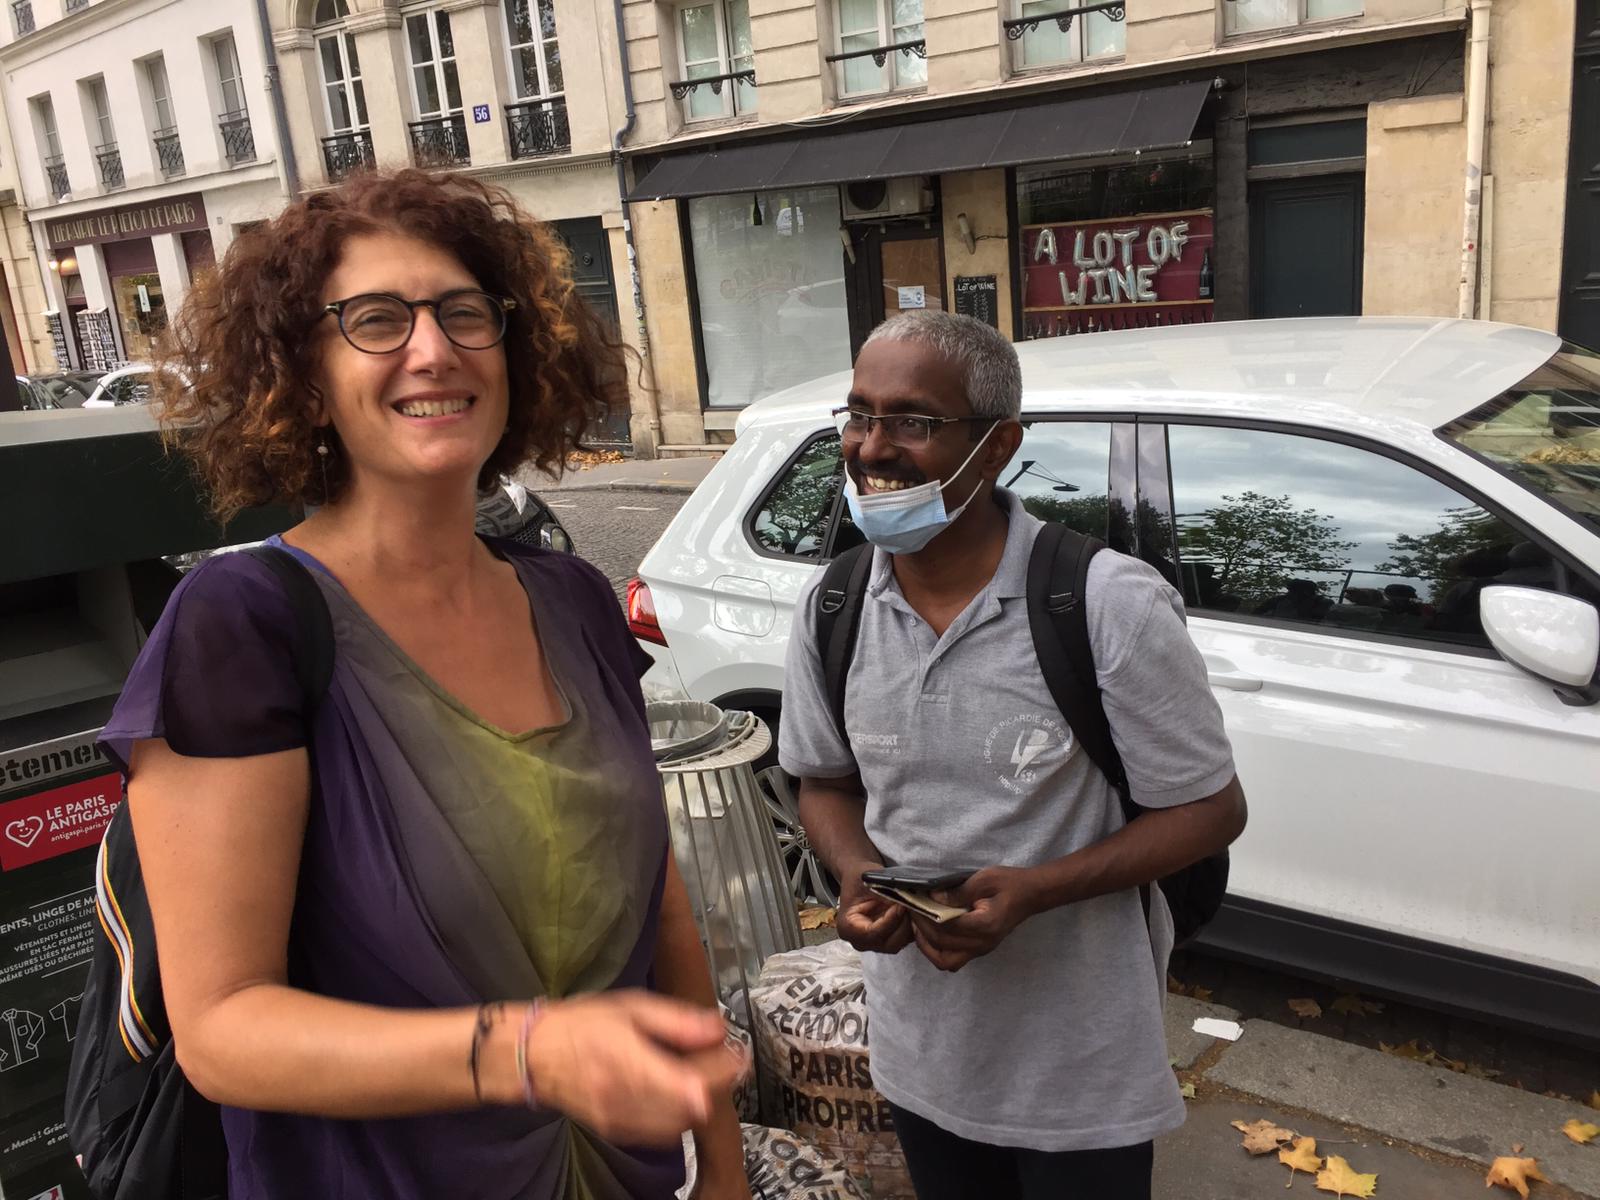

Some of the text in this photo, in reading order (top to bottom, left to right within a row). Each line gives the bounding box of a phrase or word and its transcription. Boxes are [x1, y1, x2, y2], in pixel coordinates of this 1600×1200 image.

[475, 107, 488, 120] 56
[53, 218, 96, 242] LIBRAIRIE
[97, 215, 110, 236] LE
[149, 206, 165, 228] DE
[163, 202, 195, 226] PARIS
[1034, 221, 1190, 268] A LOT OF
[957, 282, 970, 291] LOT
[977, 281, 996, 290] WINE
[1059, 264, 1158, 305] WINE
[983, 738, 993, 764] LIGUE
[999, 714, 1041, 728] PICARDIE
[1042, 718, 1056, 729] DE
[46, 794, 106, 820] LE PARIS
[32, 905, 66, 923] LINGE
[67, 899, 82, 911] DE
[14, 921, 92, 952] VÊTEMENTS ET LINGE
[30, 947, 41, 956] EN
[42, 942, 58, 952] SAC
[58, 931, 83, 946] FERMÉ
[39, 949, 60, 961] LIÉES
[61, 943, 76, 954] PAR
[24, 963, 44, 975] USÉS
[44, 959, 57, 968] OU
[788, 1046, 874, 1090] PARIS
[782, 1083, 895, 1133] PROPRE
[11, 1133, 37, 1151] Merci
[47, 1137, 56, 1146] et
